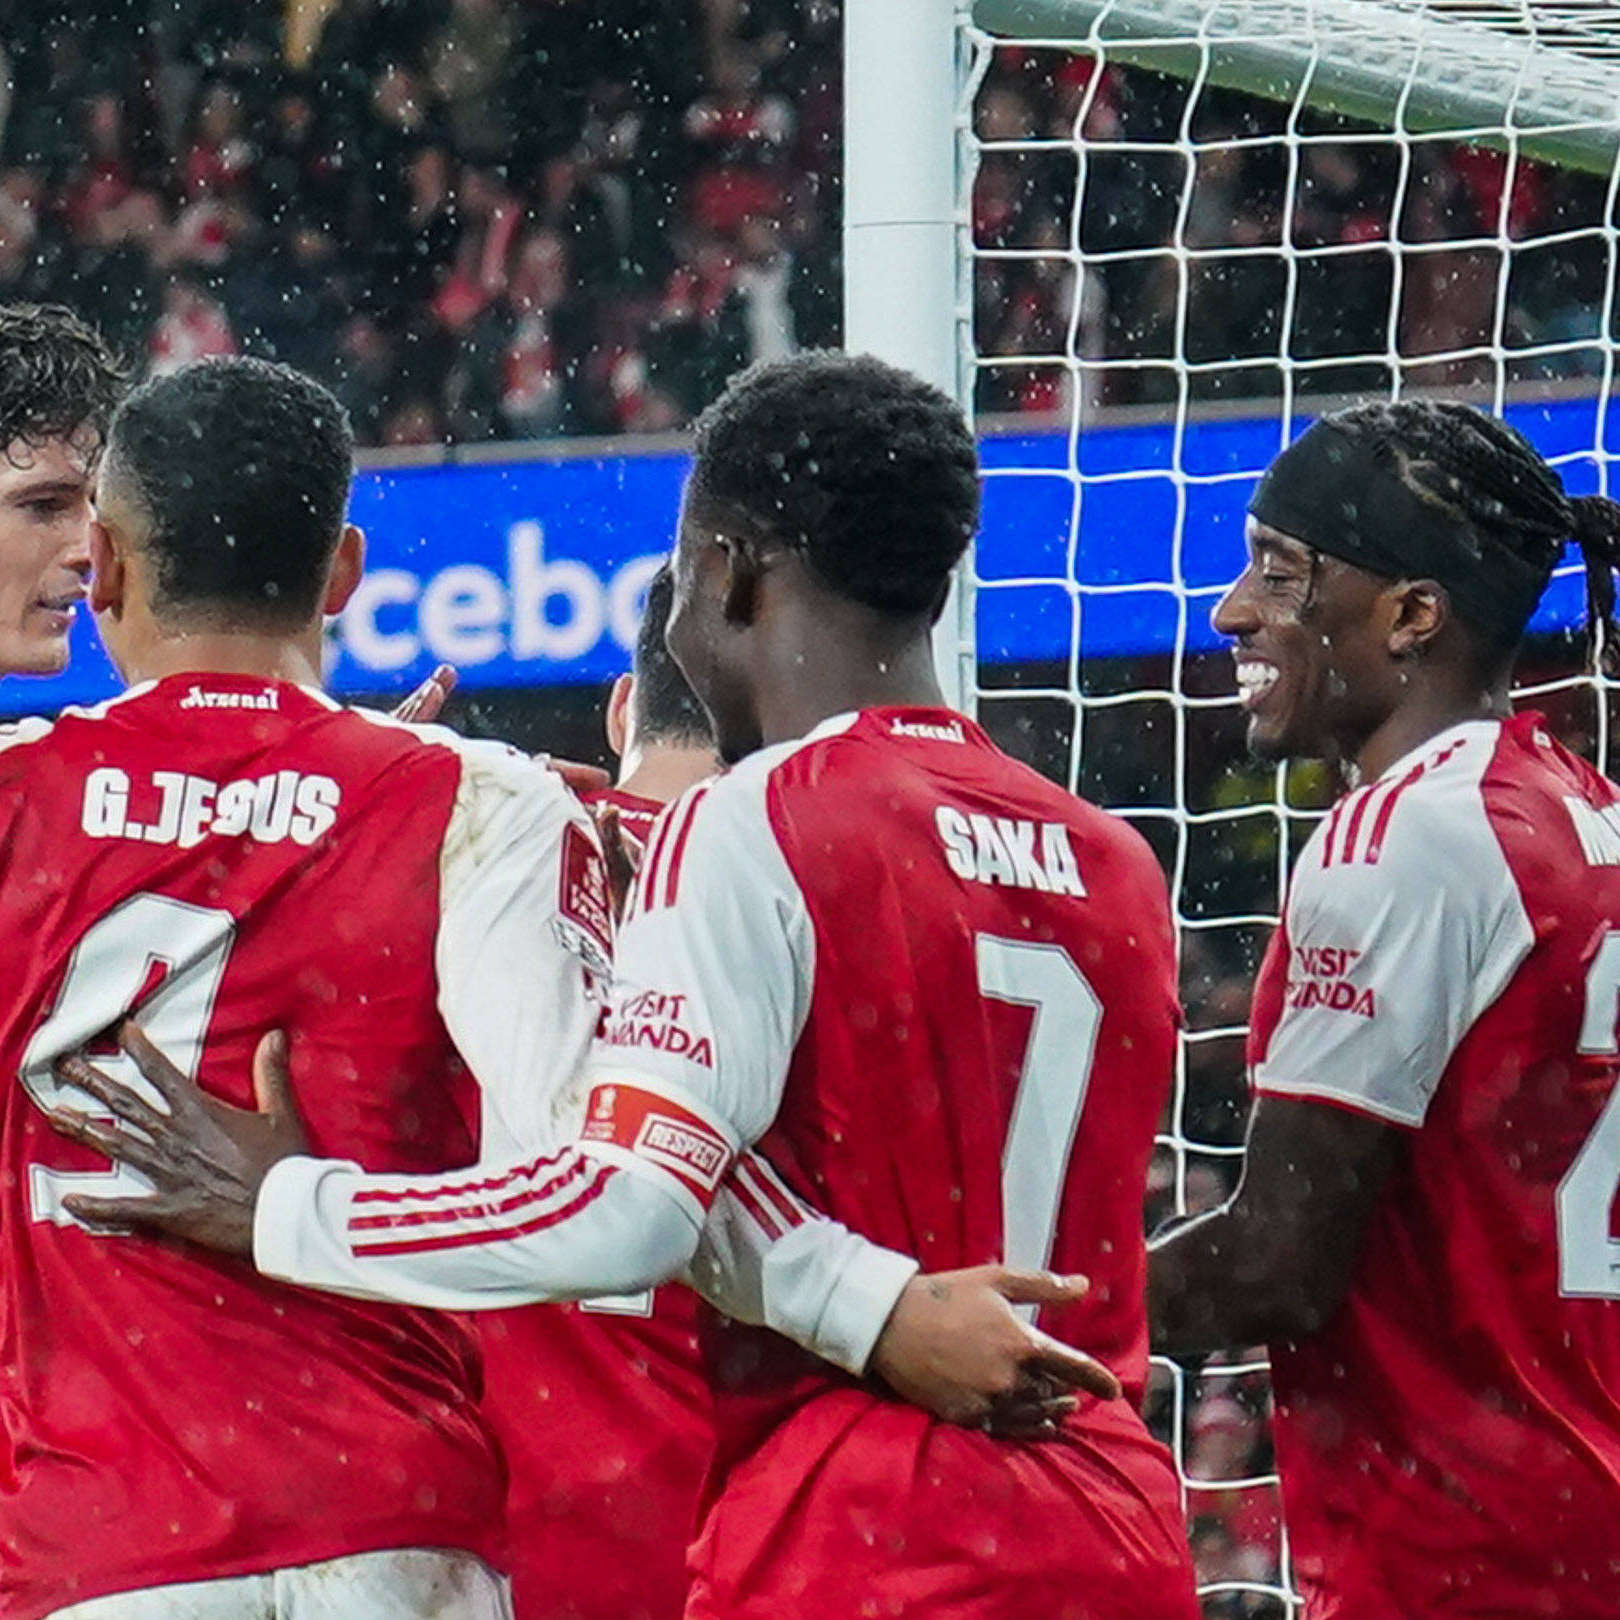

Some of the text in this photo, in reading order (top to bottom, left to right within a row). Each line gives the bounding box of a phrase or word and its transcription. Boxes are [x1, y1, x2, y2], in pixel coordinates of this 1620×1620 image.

[179, 685, 280, 711] Arsenal
[934, 805, 1088, 898] SAKA
[976, 931, 1105, 1328] 7
